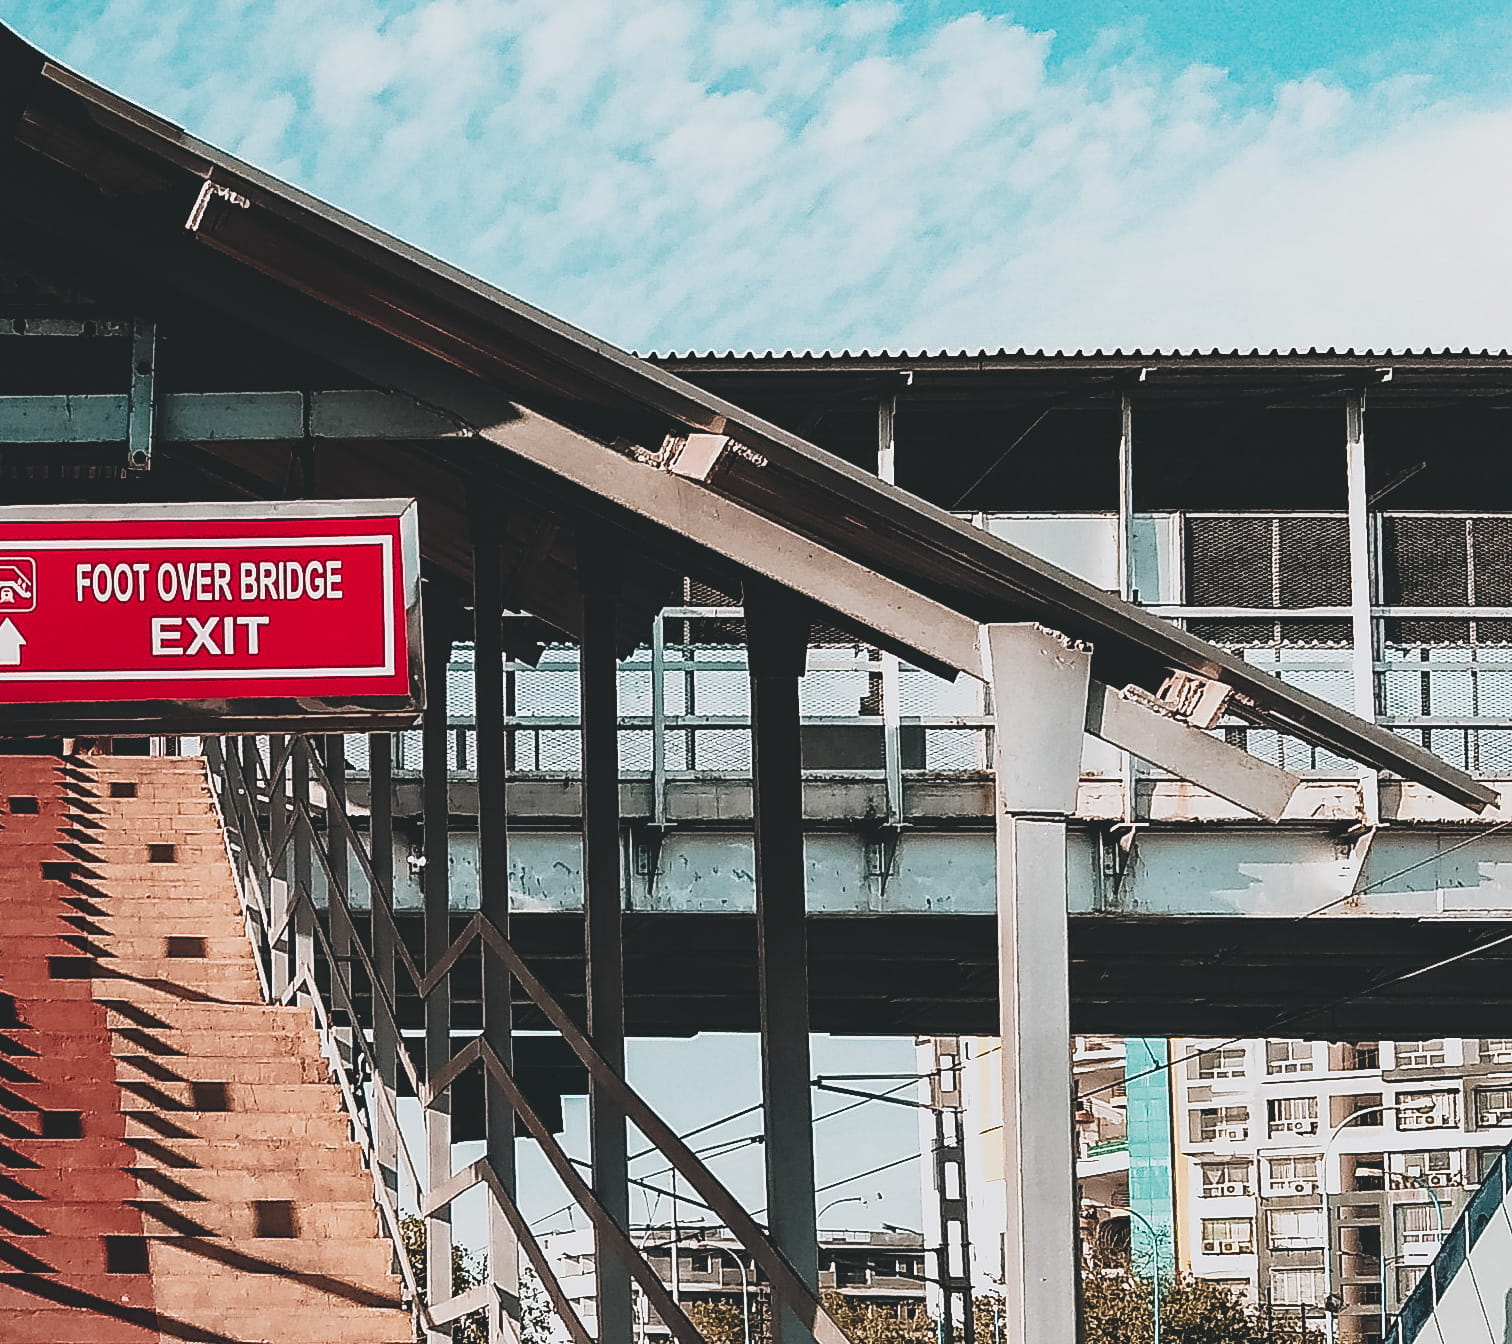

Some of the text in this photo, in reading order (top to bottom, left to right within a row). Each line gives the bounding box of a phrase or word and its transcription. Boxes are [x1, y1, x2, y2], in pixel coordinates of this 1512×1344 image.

[76, 559, 344, 603] FOOT OVER BRIDGE
[151, 616, 270, 657] EXIT
